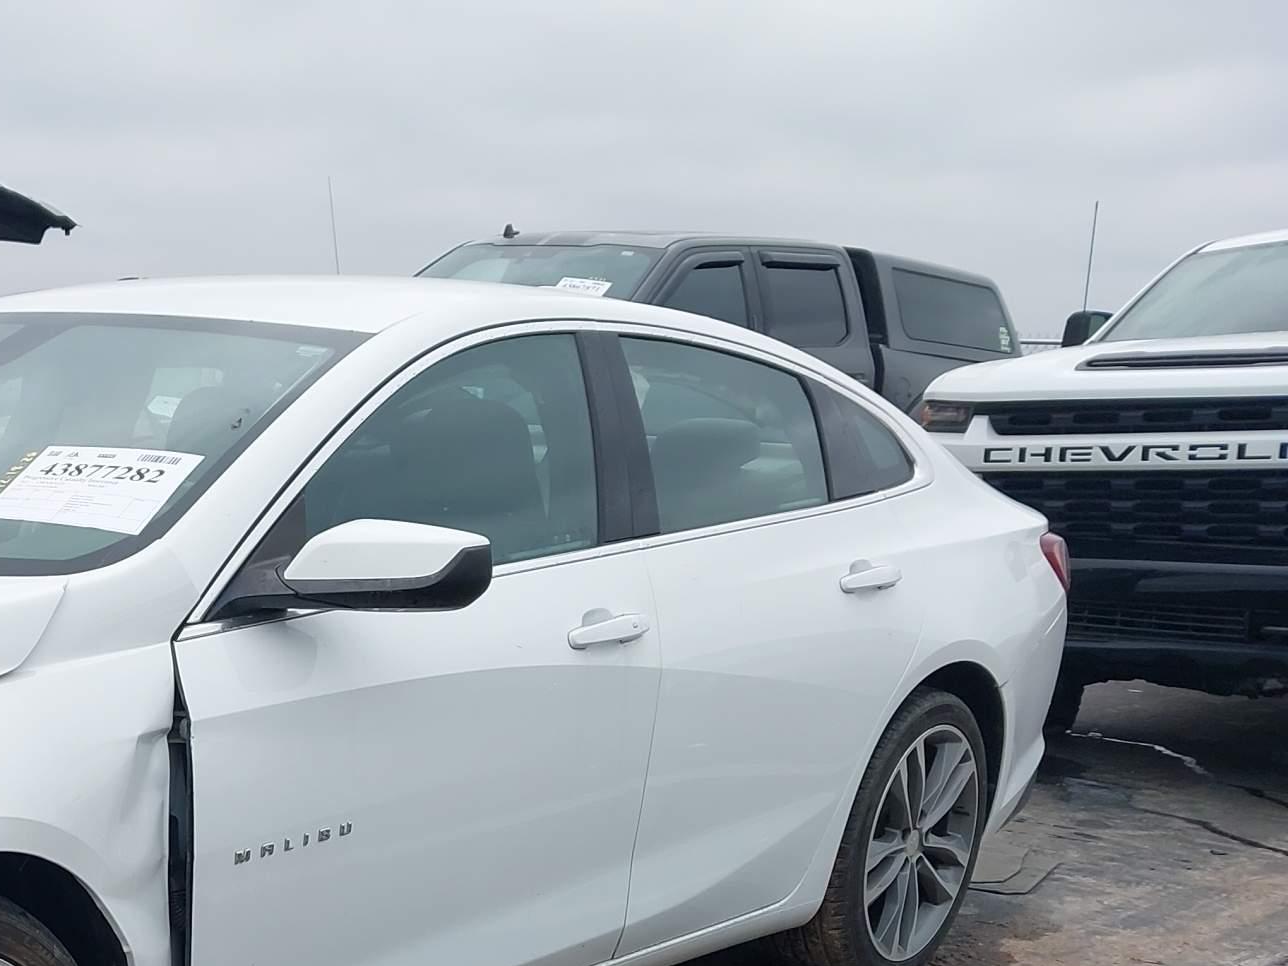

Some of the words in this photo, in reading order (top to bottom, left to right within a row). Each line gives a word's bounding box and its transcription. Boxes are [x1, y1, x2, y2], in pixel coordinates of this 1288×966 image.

[983, 442, 1288, 463] CHEVROL
[40, 462, 165, 483] 43877282
[234, 821, 353, 865] MALIBU
